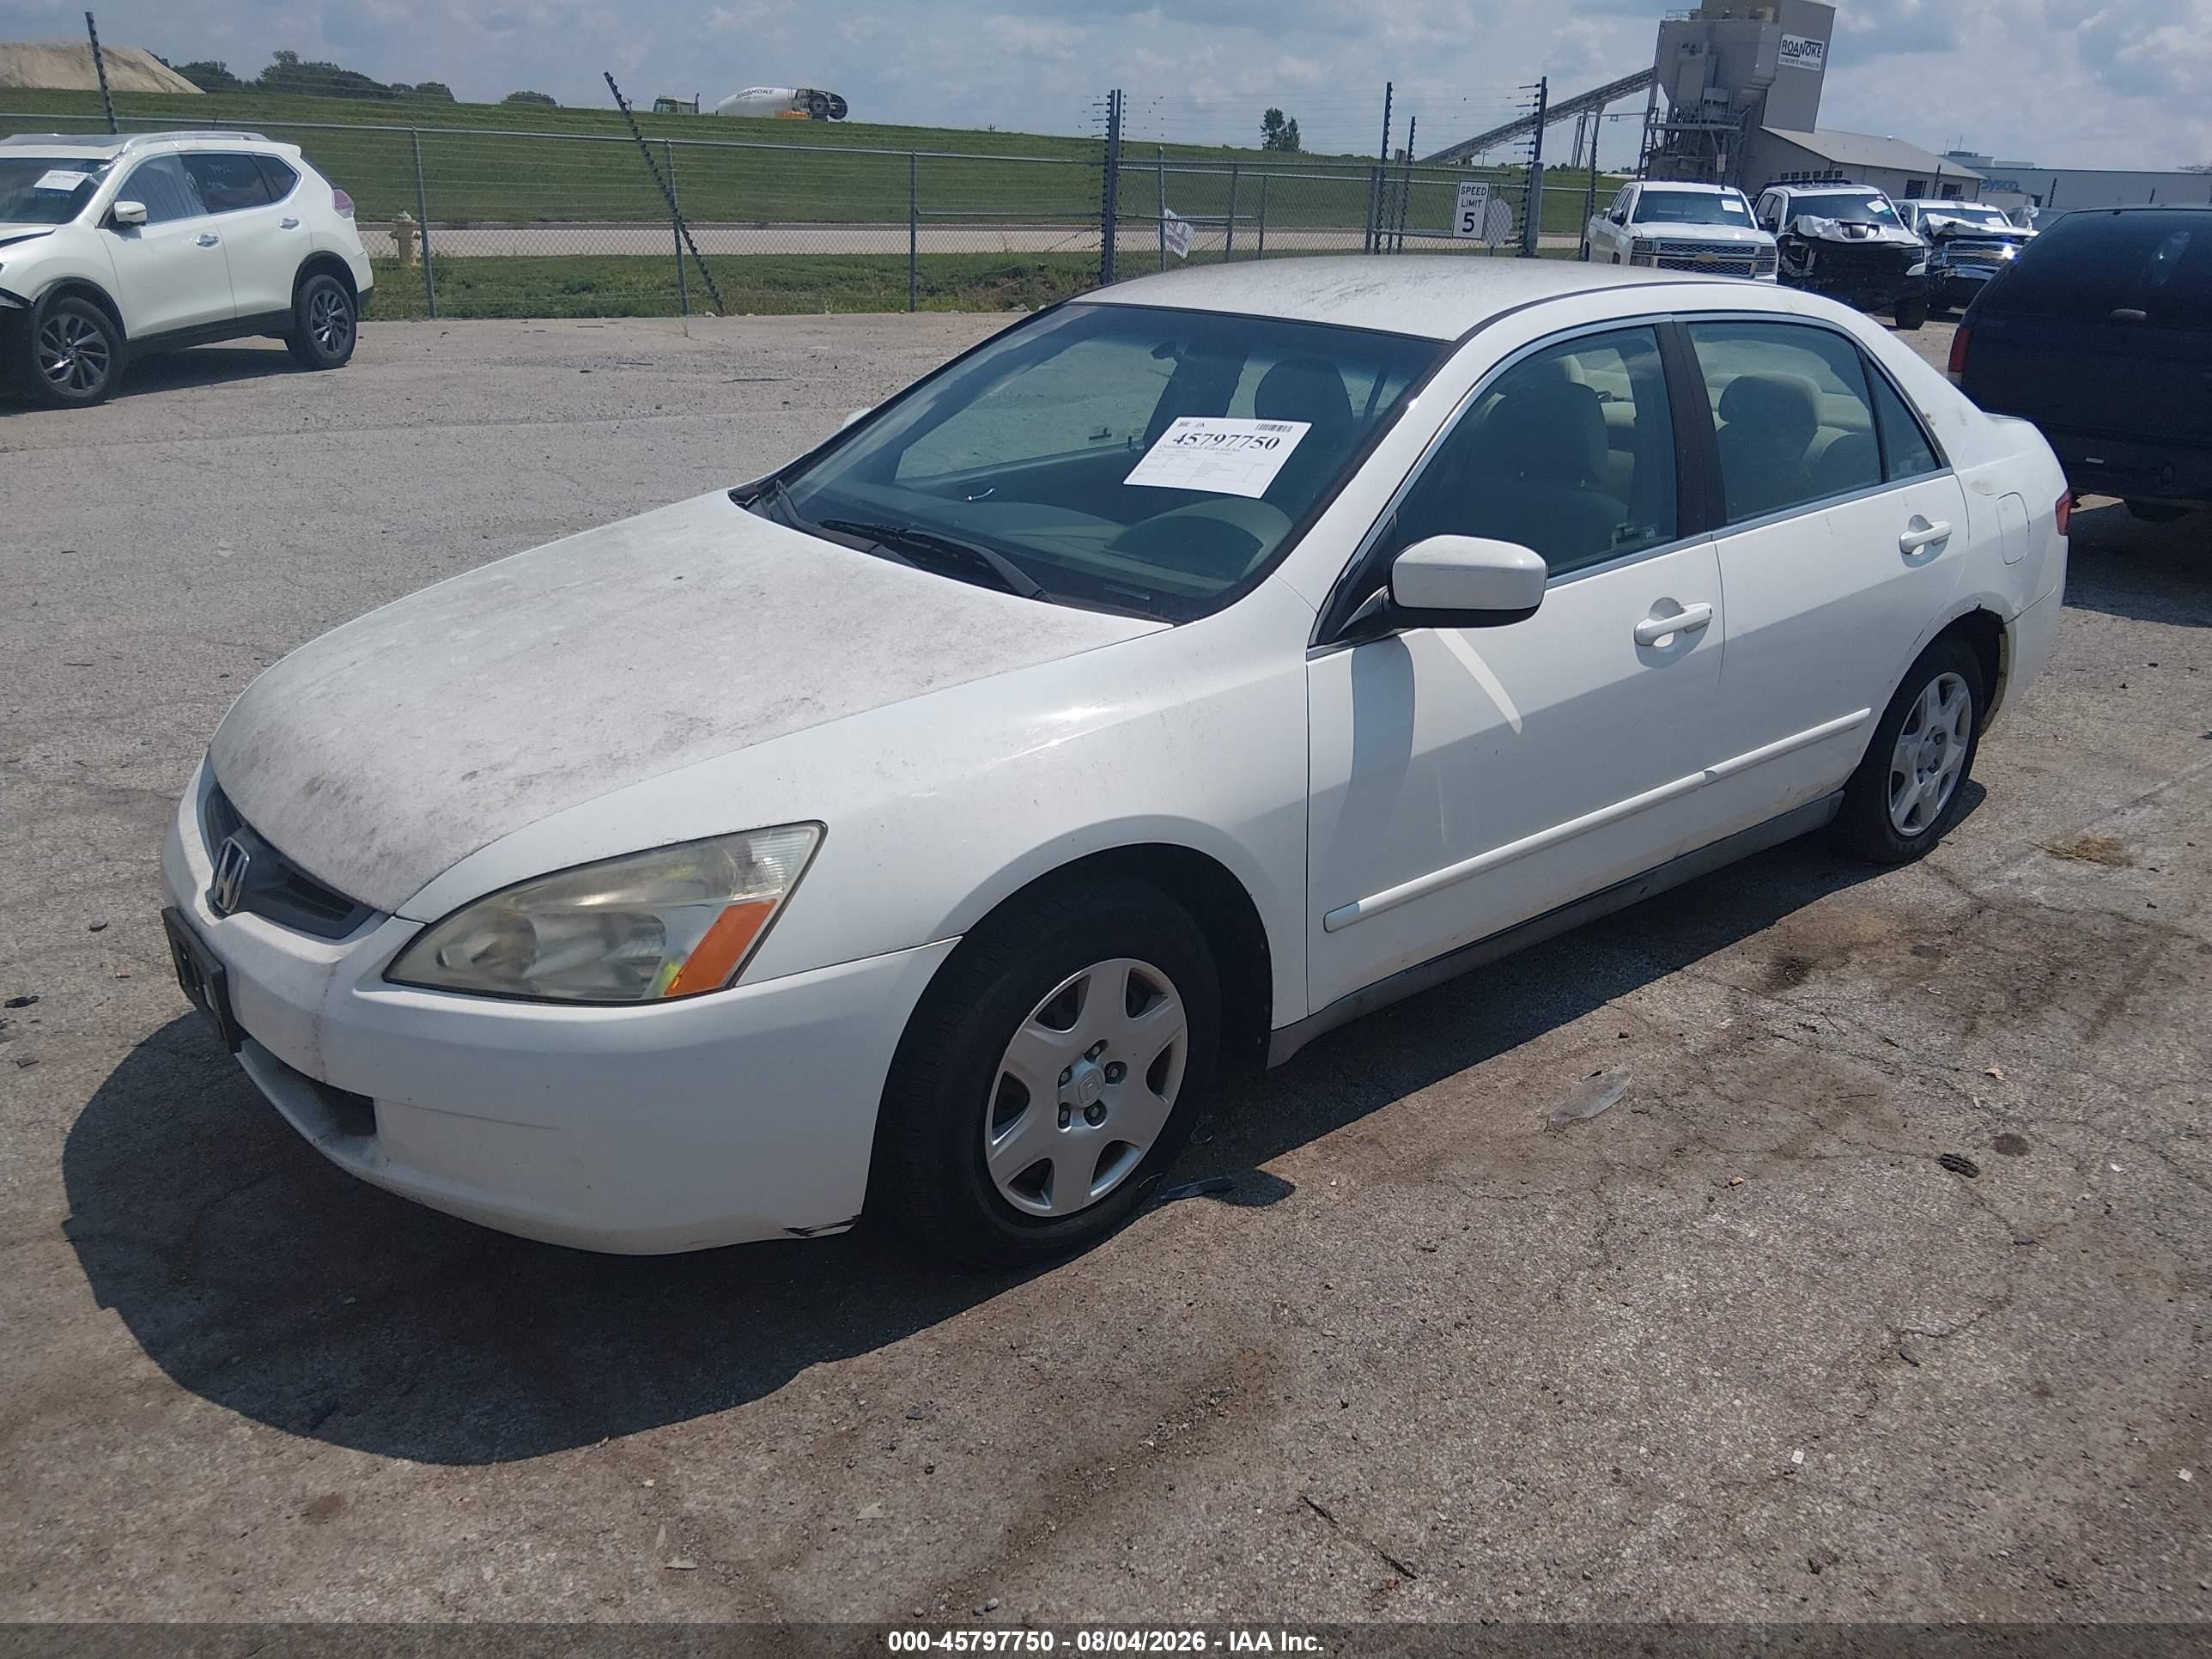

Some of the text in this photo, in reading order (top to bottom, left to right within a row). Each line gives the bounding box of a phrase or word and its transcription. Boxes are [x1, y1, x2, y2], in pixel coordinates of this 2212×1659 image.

[1781, 40, 1822, 58] ROANOKE
[1461, 186, 1486, 196] SPEED
[1462, 199, 1482, 208] LIMIT
[1462, 212, 1475, 234] 5
[1172, 432, 1281, 451] 45797750
